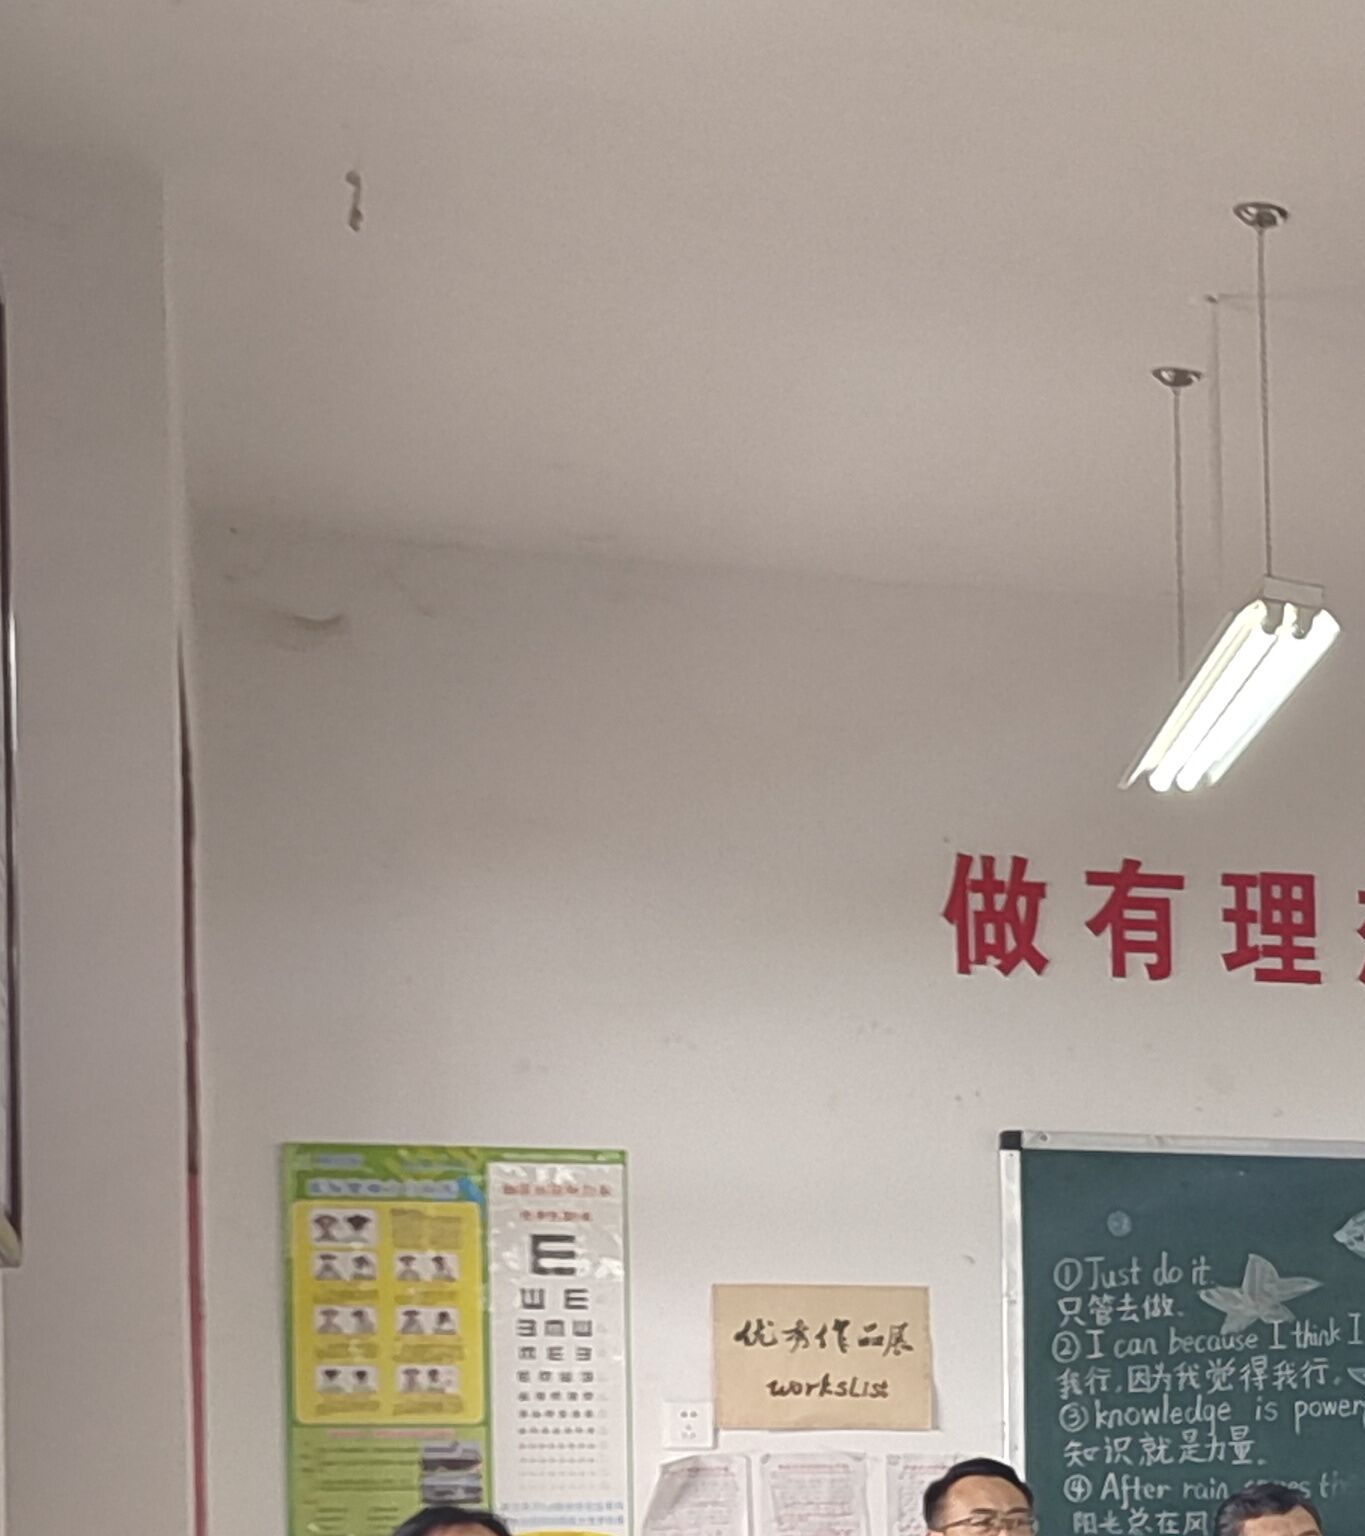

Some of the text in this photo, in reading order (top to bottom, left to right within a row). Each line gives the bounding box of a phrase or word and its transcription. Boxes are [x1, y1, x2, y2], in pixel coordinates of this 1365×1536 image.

[1152, 1251, 1183, 1286] do
[1113, 1336, 1158, 1359] can
[1168, 1327, 1259, 1354] because
[1268, 1320, 1287, 1350] I
[1291, 1318, 1341, 1349] think
[1348, 1313, 1363, 1346] I
[1254, 1396, 1278, 1421] is
[1182, 1476, 1229, 1499] rain
